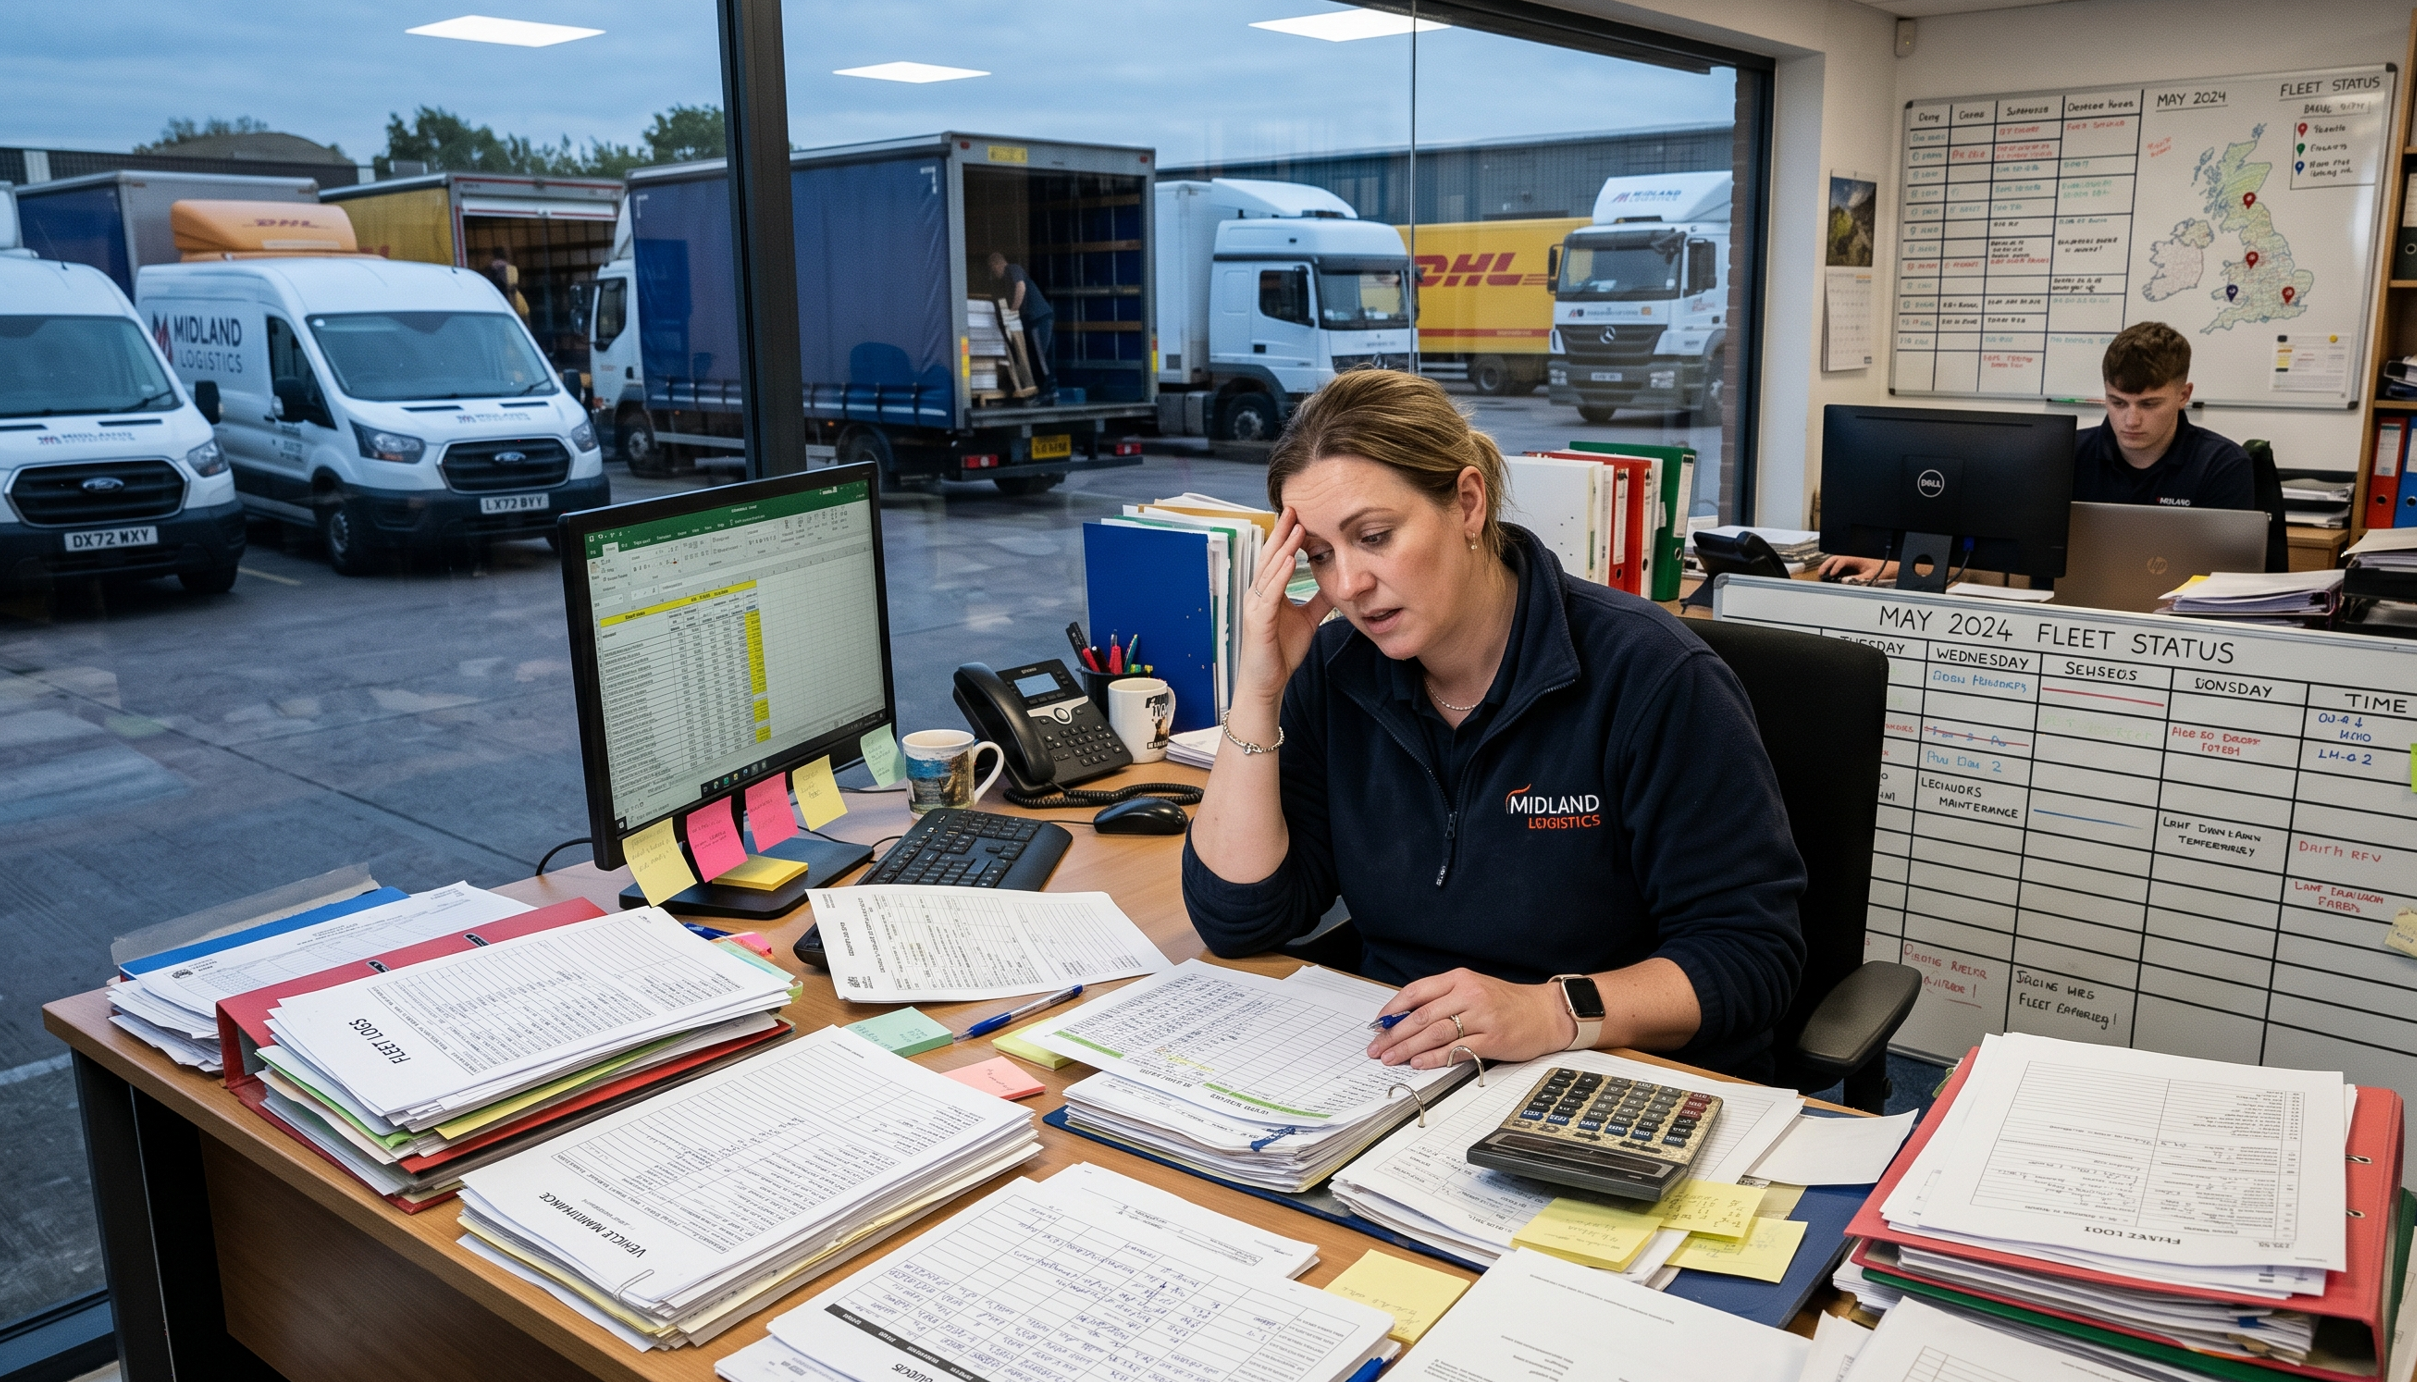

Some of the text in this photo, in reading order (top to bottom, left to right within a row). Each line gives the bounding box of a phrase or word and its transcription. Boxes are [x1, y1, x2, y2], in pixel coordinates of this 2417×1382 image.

[2280, 76, 2380, 97] FLEET STATUS
[2157, 91, 2226, 107] MAY 2024
[1413, 252, 1516, 288] DHL
[173, 315, 242, 347] MIDLAND
[180, 349, 243, 374] LOGISTICS
[485, 496, 543, 511] LX72 BYY
[72, 528, 149, 548] DX72 WXY
[1880, 605, 2234, 664] MAY 2024 FLEET STATUS
[1936, 648, 2029, 670] WEDNESDAY
[2345, 693, 2407, 713] TIME
[1510, 794, 1600, 815] MIDLAND
[1528, 814, 1601, 830] LOGISTICS
[348, 1018, 411, 1064] FLEET LOGS
